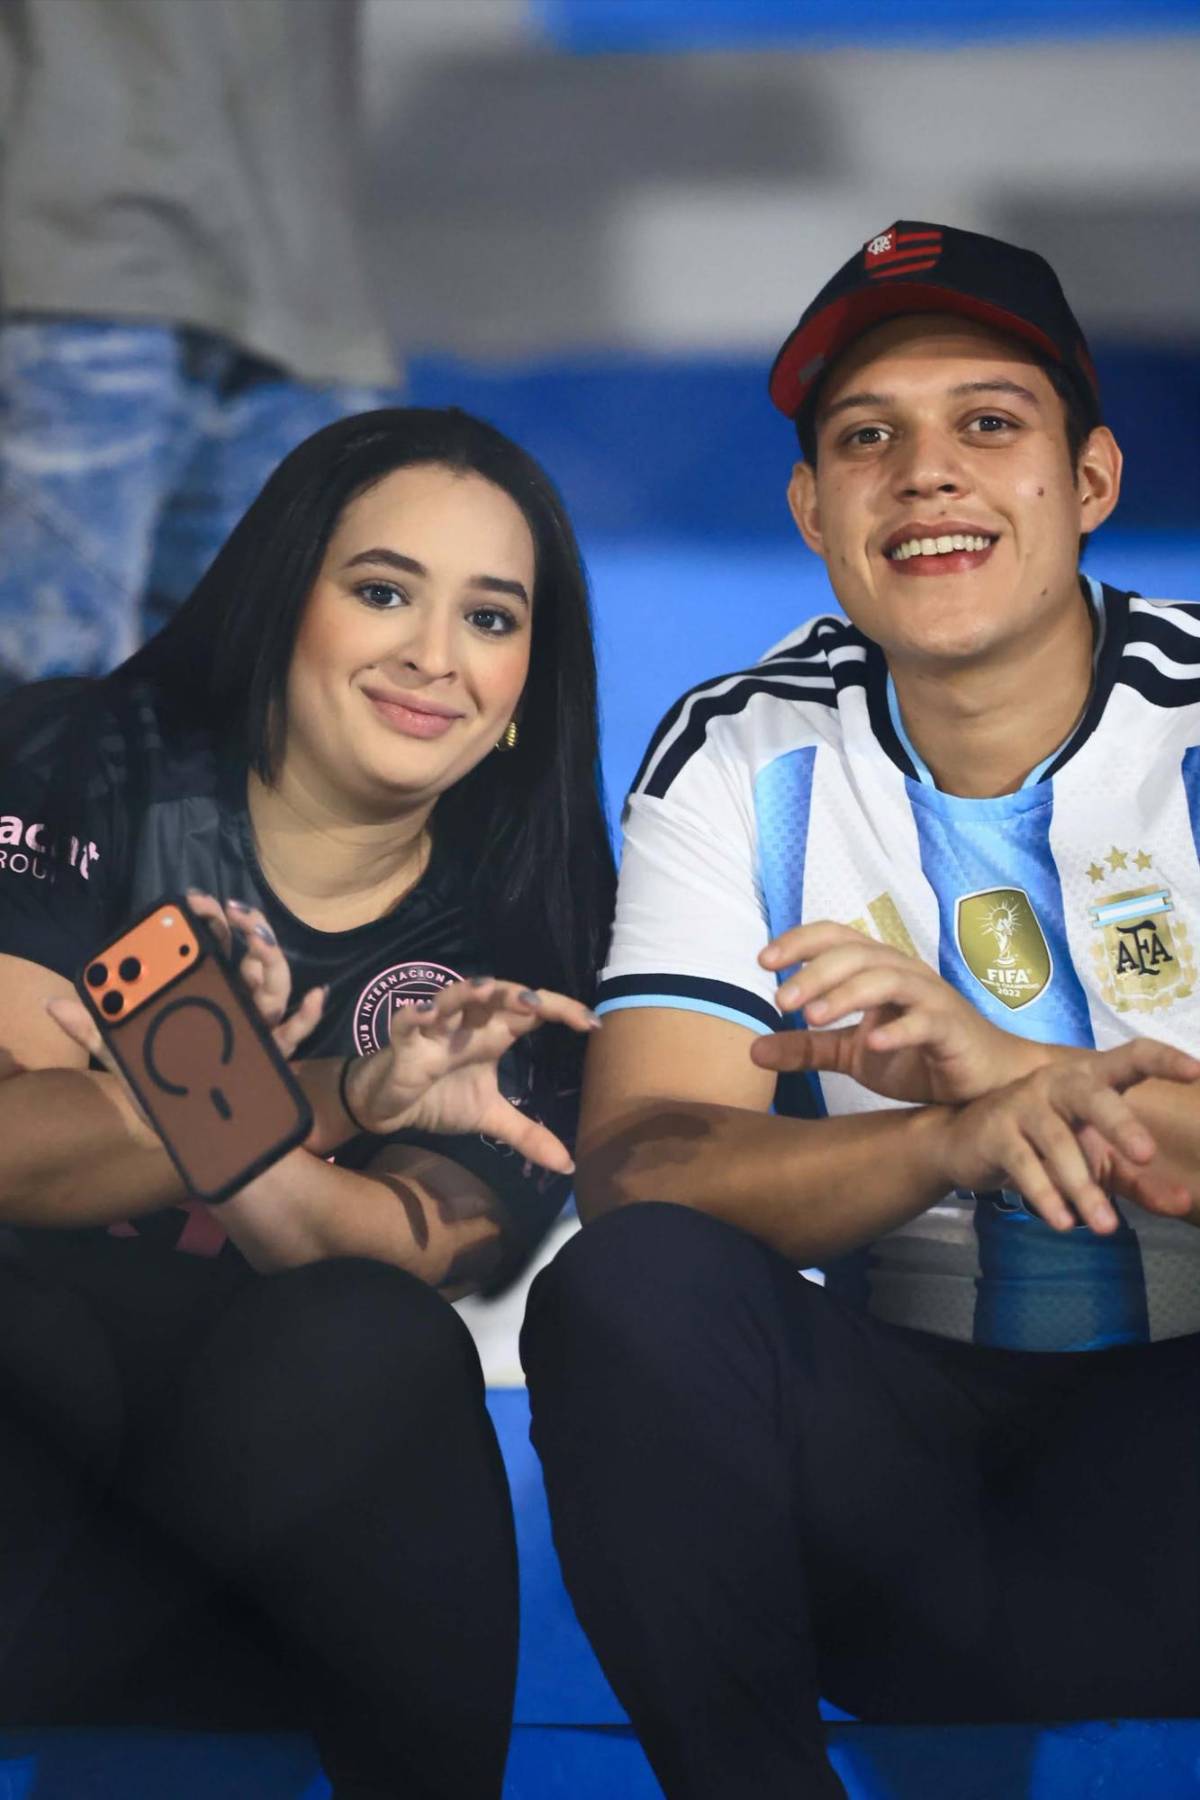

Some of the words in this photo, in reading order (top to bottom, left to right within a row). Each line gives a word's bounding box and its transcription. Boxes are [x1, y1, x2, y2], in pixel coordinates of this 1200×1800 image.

[1116, 919, 1173, 976] AFA
[987, 968, 1030, 984] FIFA
[997, 987, 1021, 998] 2022
[360, 1024, 375, 1055] LUB
